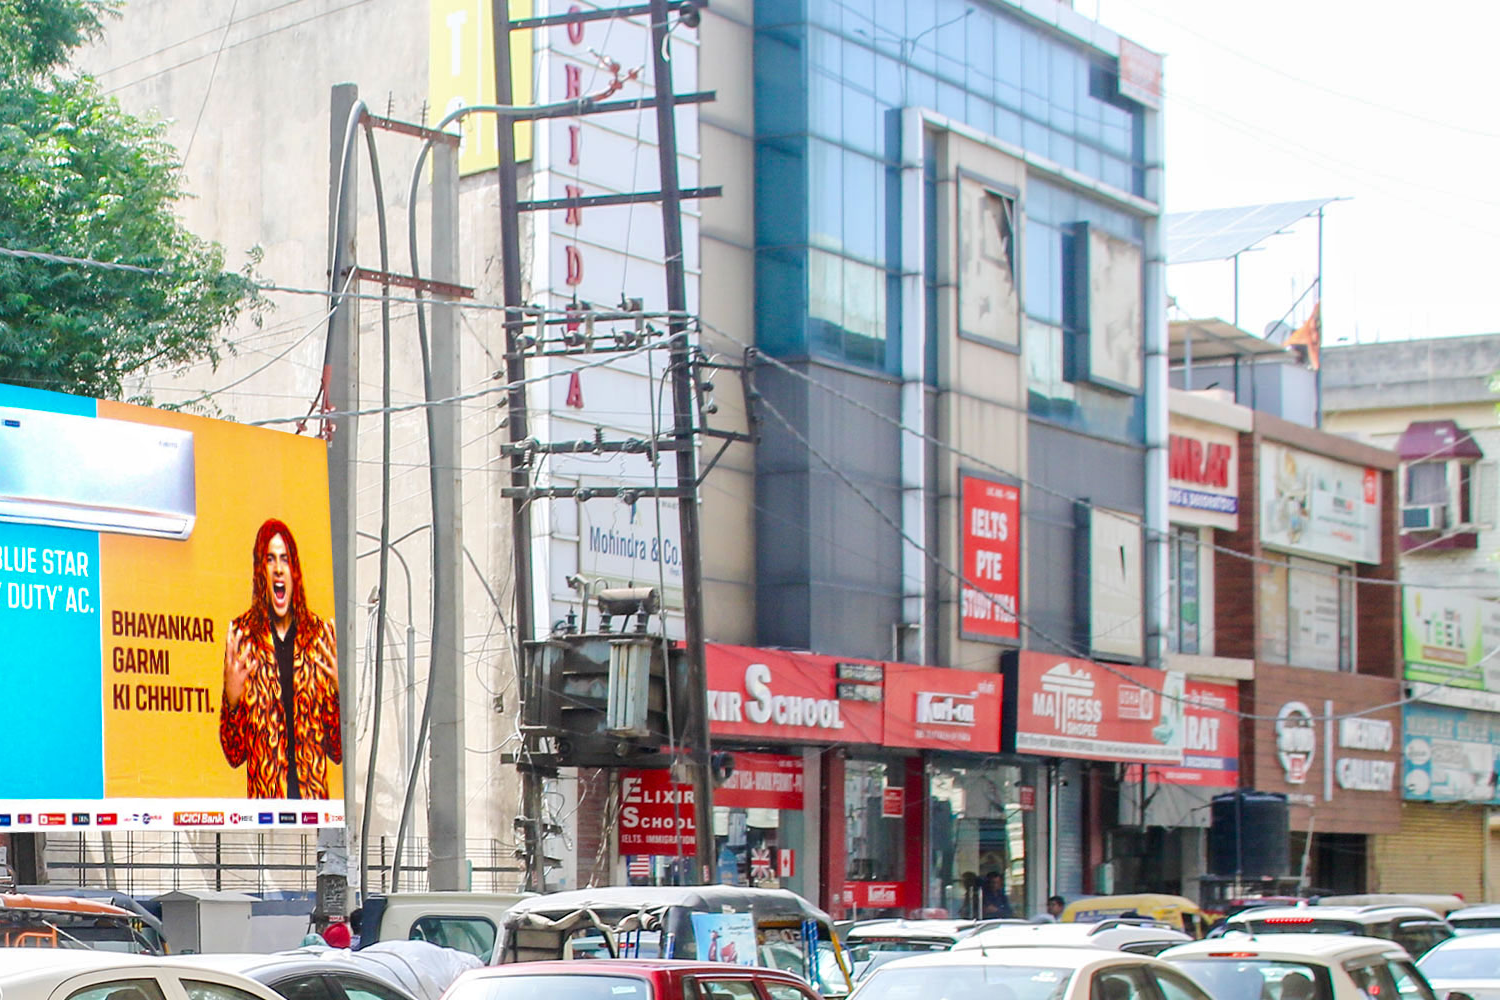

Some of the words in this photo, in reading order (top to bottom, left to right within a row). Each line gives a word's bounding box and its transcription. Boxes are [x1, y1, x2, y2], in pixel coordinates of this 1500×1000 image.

[971, 507, 1008, 541] IELTS
[590, 526, 646, 560] Mohindra
[651, 537, 661, 562] &
[664, 539, 681, 565] Co.
[43, 550, 89, 577] STAR
[976, 549, 1002, 581] PTE
[66, 587, 94, 613] AC.
[112, 610, 214, 643] BHAYANKAR
[113, 647, 170, 675] GARMI
[113, 684, 129, 711] KI
[135, 685, 215, 713] CHHUTTI.
[707, 690, 743, 722] XIR
[745, 663, 844, 729] SCHOOL
[622, 777, 695, 803] ELIXIR
[201, 813, 223, 824] Bank
[622, 806, 696, 830] SCHOOL
